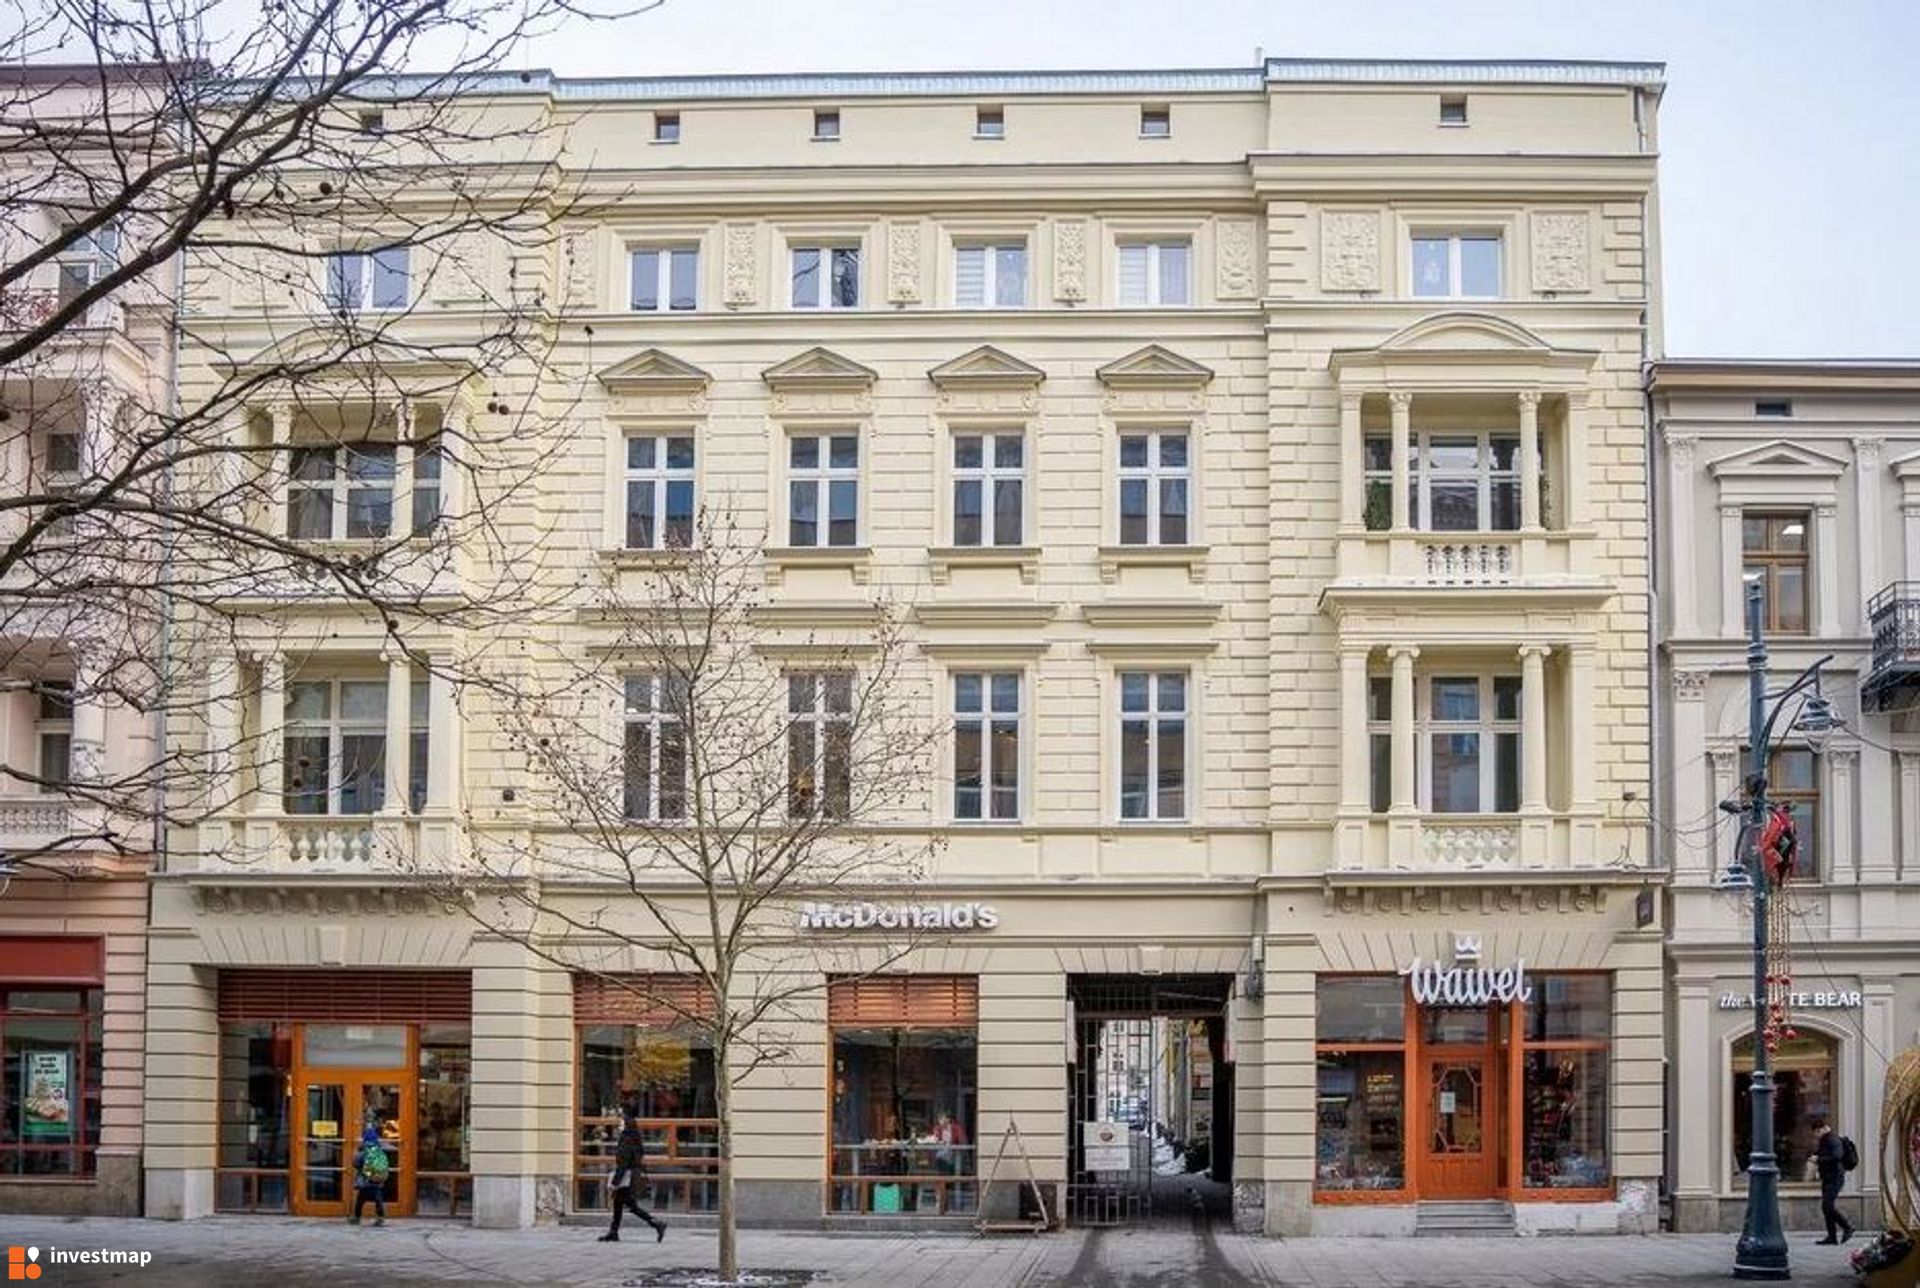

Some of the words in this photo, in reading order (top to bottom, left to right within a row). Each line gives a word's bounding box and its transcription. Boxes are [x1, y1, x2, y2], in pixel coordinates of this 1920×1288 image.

[800, 902, 999, 929] McDonald's
[1398, 957, 1532, 1004] Wawel
[1720, 991, 1746, 1008] the
[1815, 992, 1862, 1007] BEAR
